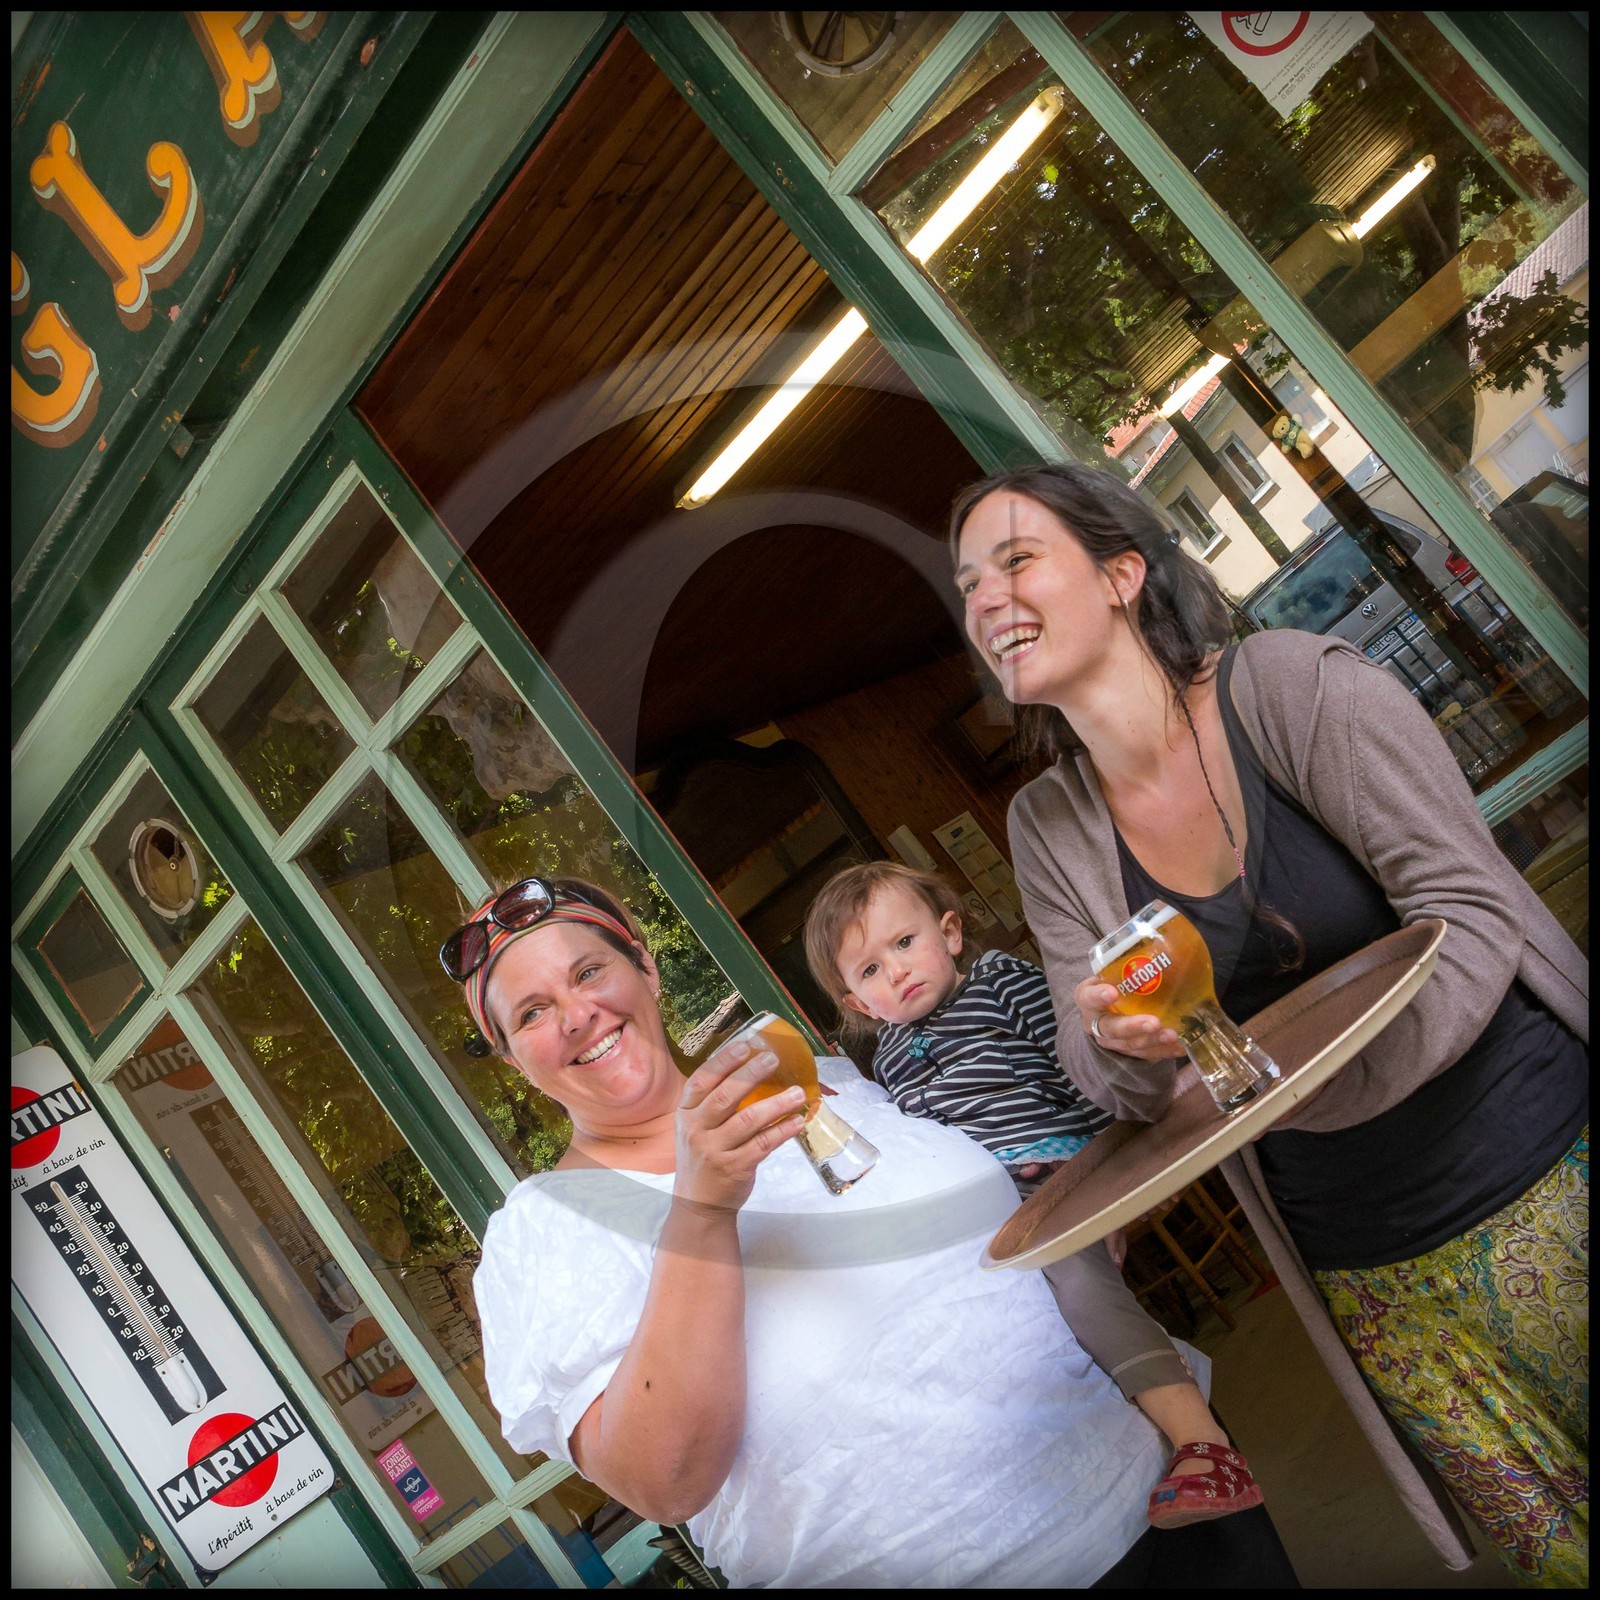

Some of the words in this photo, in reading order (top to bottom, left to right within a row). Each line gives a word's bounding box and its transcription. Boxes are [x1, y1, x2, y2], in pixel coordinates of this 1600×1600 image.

[1116, 951, 1172, 997] PELFORTH
[51, 1153, 75, 1170] base
[76, 1146, 88, 1158] de
[89, 1138, 106, 1151] vin
[75, 1181, 89, 1192] 50
[34, 1201, 48, 1213] 50
[90, 1201, 102, 1212] 40
[49, 1222, 62, 1233] 40
[102, 1221, 116, 1233] 30
[62, 1243, 76, 1254] 30
[116, 1242, 129, 1254] 20
[77, 1263, 89, 1275] 20
[132, 1262, 143, 1273] 10
[92, 1284, 104, 1296] 10
[146, 1284, 155, 1293] 0
[107, 1307, 115, 1316] 0
[159, 1304, 170, 1315] 10
[120, 1327, 132, 1338] 10
[171, 1325, 184, 1337] 20
[132, 1348, 145, 1361] 20
[163, 1407, 299, 1517] MARTINI
[382, 1446, 407, 1473] LONELY
[388, 1455, 413, 1480] PLANET
[207, 1515, 254, 1556] l'Apéritif
[266, 1500, 274, 1515] à
[275, 1487, 297, 1507] base
[296, 1479, 308, 1493] de
[308, 1466, 325, 1482] vin
